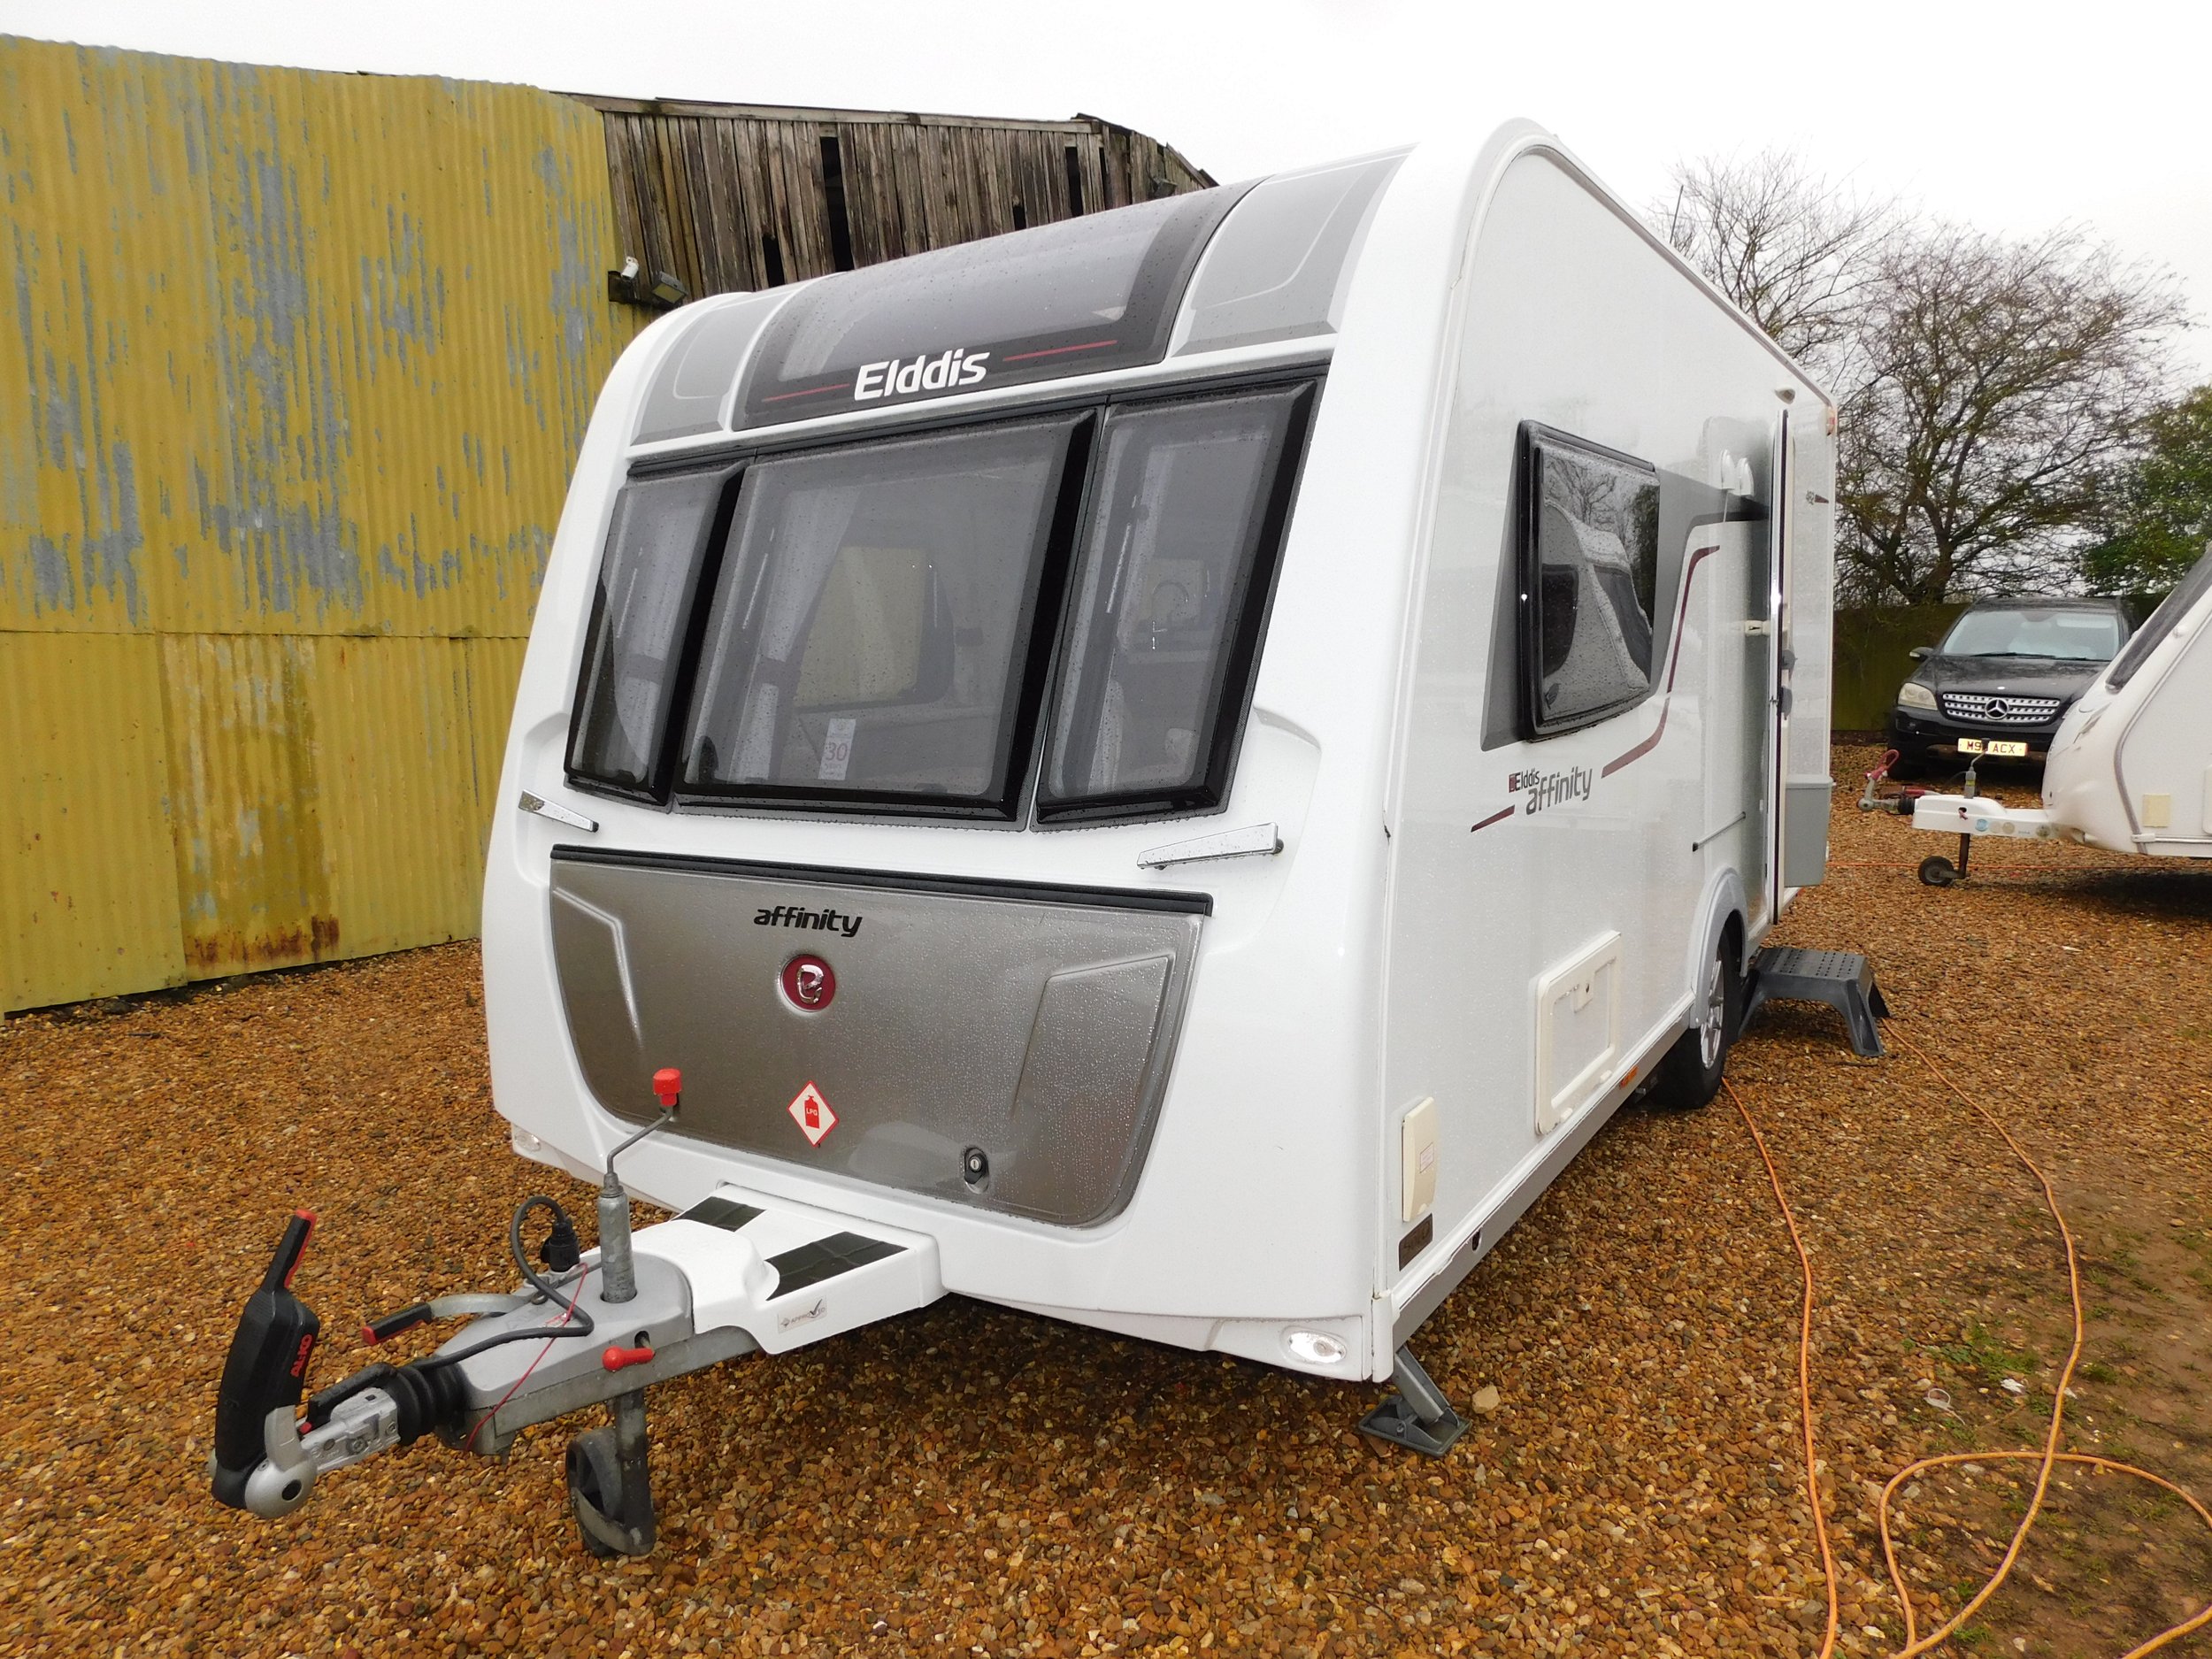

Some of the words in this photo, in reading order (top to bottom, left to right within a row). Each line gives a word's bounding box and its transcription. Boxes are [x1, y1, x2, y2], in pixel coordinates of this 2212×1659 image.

[854, 348, 990, 401] Elddis
[825, 741, 849, 761] 30
[1966, 741, 1987, 751] M9
[1993, 743, 2016, 754] ACX
[1515, 768, 1540, 791] Elddis
[1526, 766, 1593, 815] affinity
[754, 905, 863, 938] affinity
